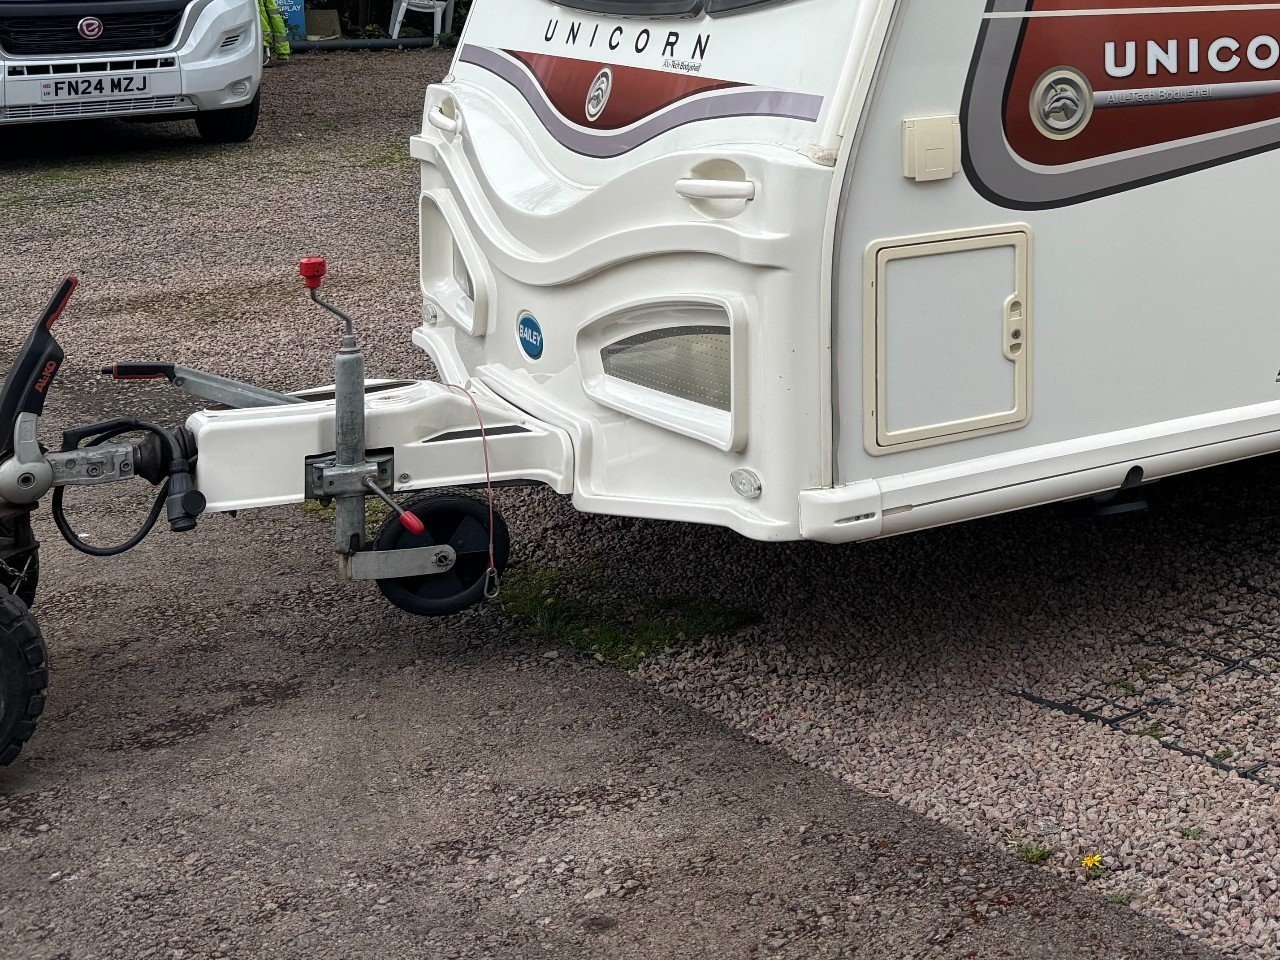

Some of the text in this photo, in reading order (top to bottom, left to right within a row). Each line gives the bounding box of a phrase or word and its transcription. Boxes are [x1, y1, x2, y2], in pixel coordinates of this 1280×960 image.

[544, 18, 711, 61] UNICORN
[54, 76, 147, 96] FN24 MZJ
[1107, 86, 1213, 105] Alu-Tech Bodyshell
[519, 324, 542, 346] BAILEY
